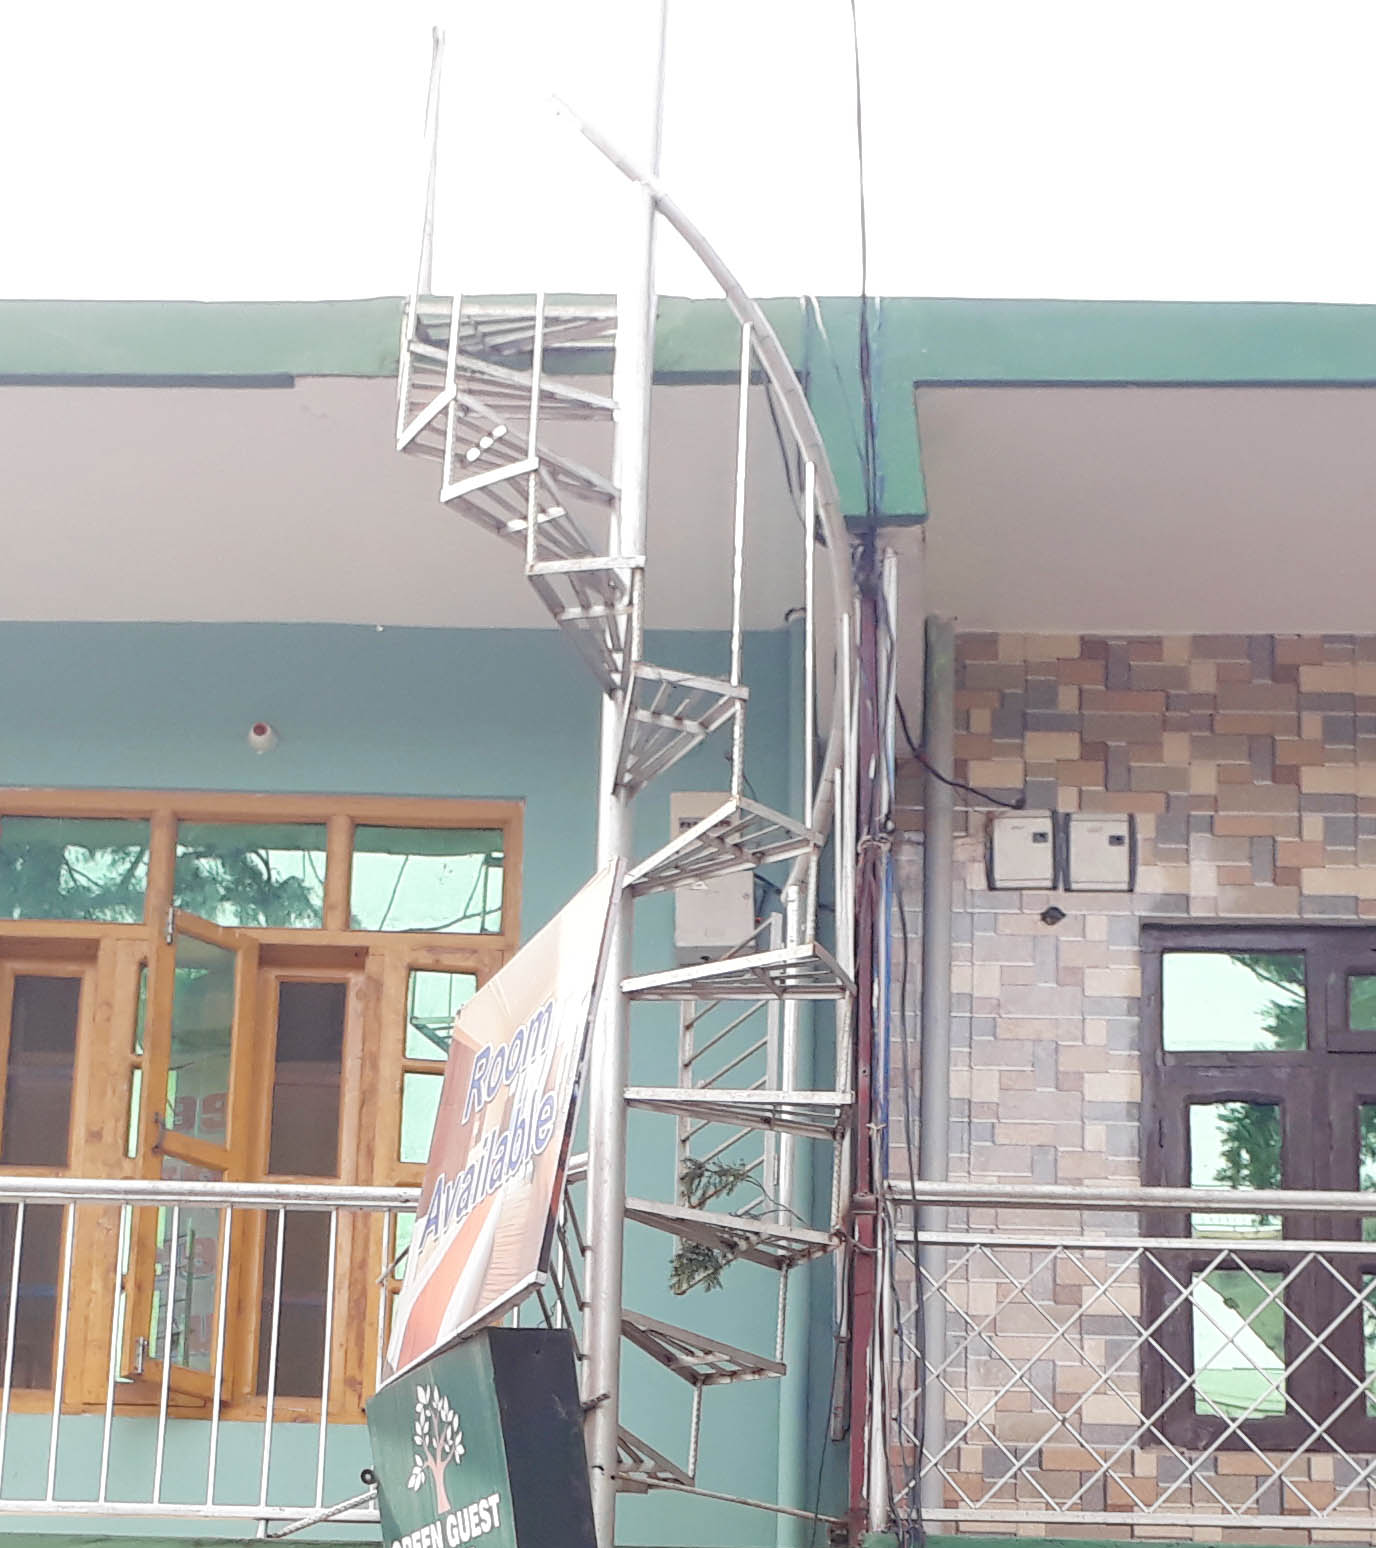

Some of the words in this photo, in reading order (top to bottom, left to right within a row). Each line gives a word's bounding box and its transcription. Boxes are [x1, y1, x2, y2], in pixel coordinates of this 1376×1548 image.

[462, 1000, 555, 1125] Room
[418, 1090, 557, 1252] Available
[446, 1493, 501, 1548] GUEST
